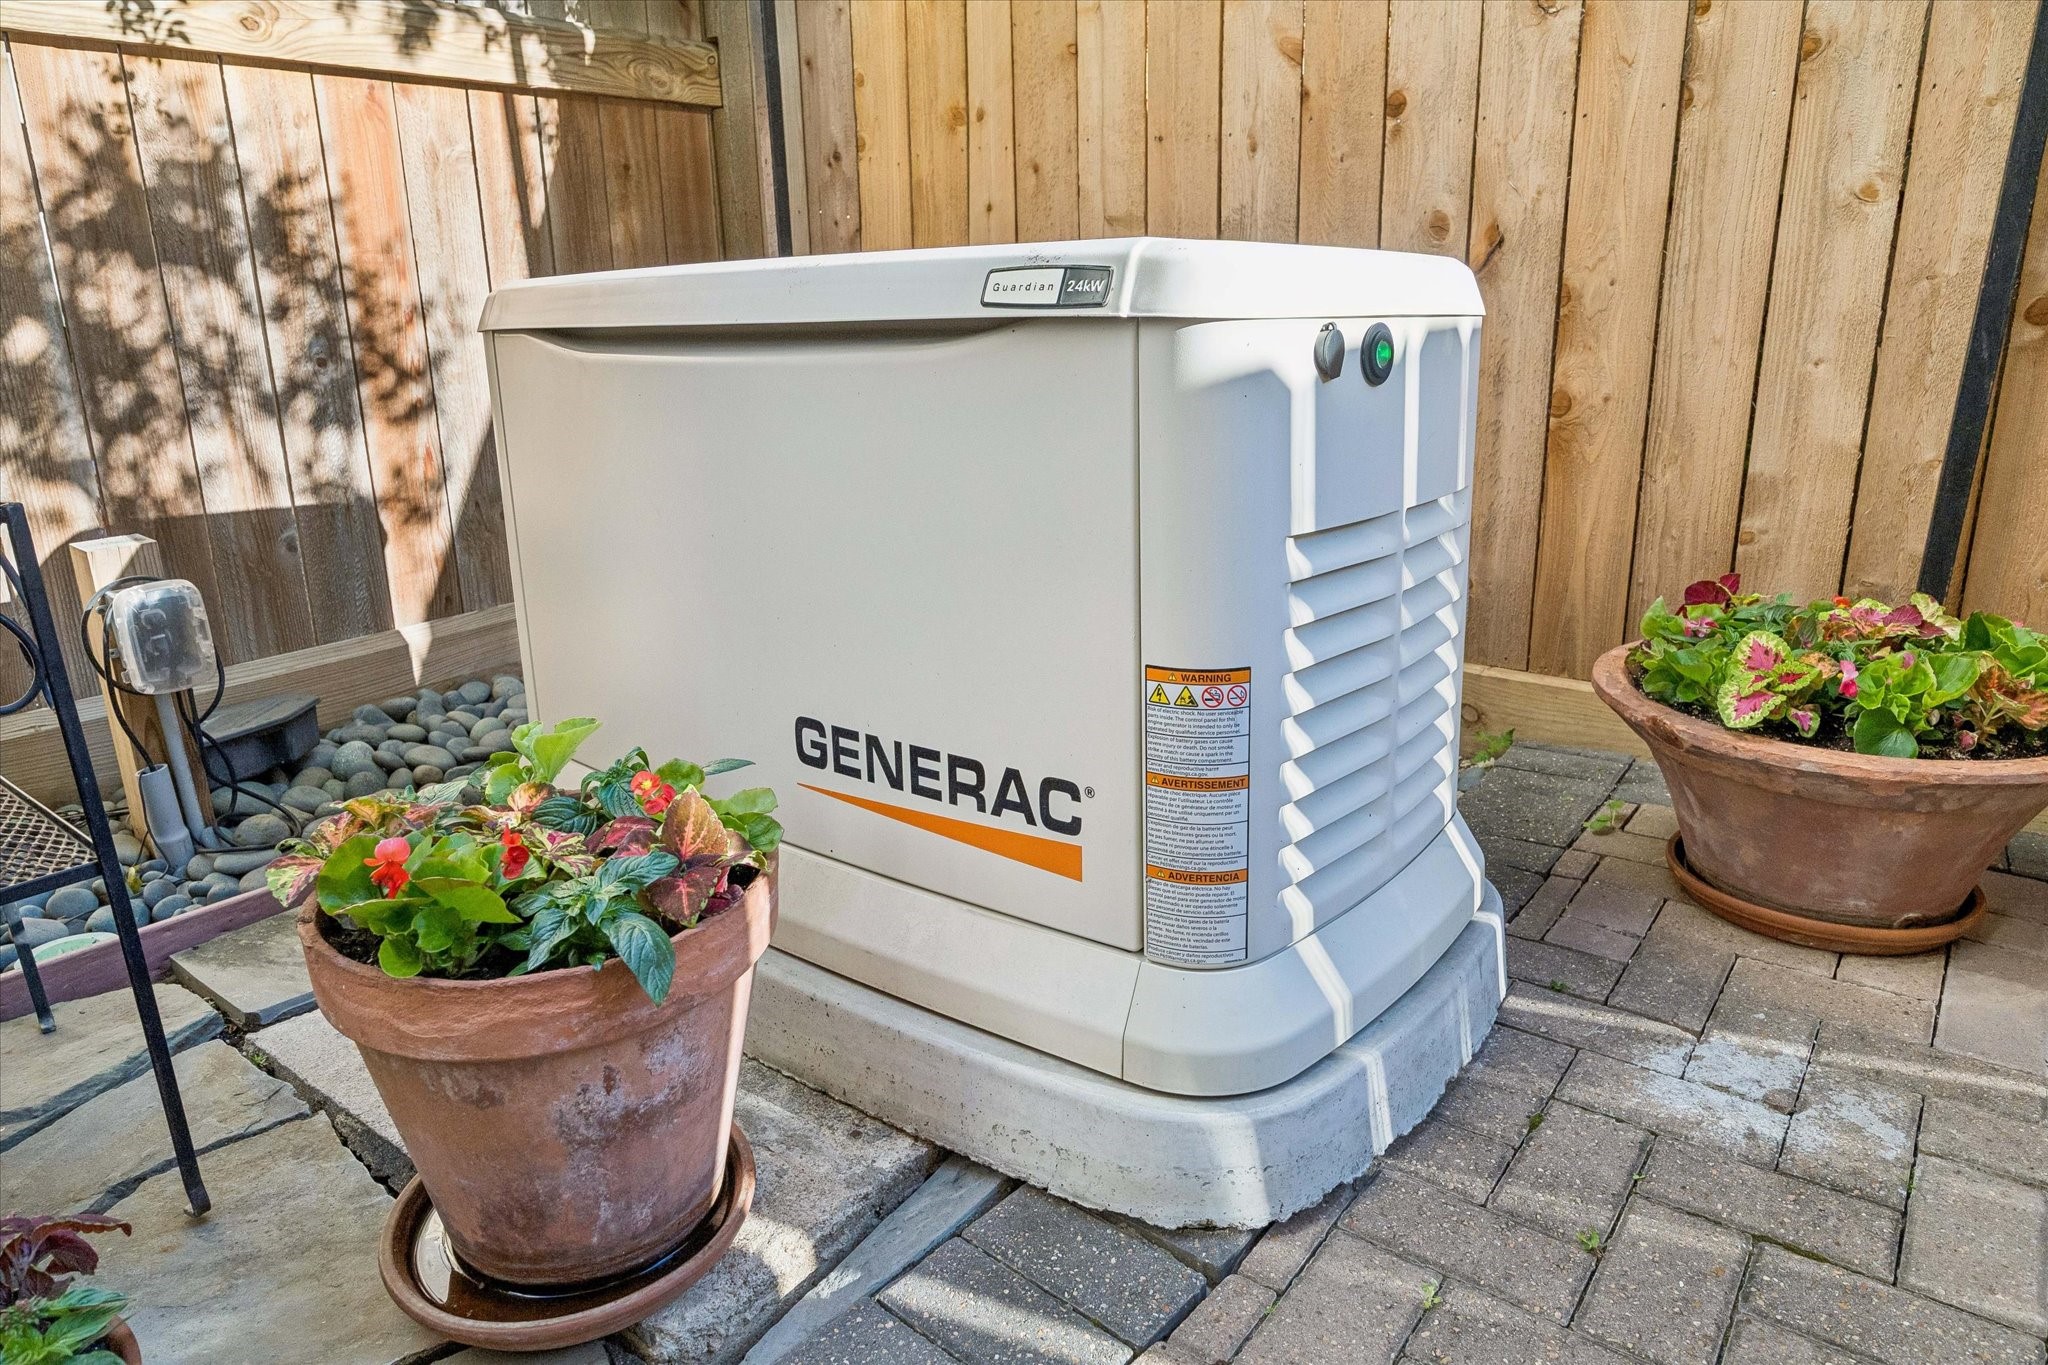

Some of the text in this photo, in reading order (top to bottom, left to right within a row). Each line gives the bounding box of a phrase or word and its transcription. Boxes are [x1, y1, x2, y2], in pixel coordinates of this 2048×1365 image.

[992, 279, 1105, 293] Guardian 24kW
[1181, 673, 1232, 683] WARNING
[1162, 778, 1245, 789] AVERTISSEMENT
[1168, 872, 1240, 882] ADVERTENCIA
